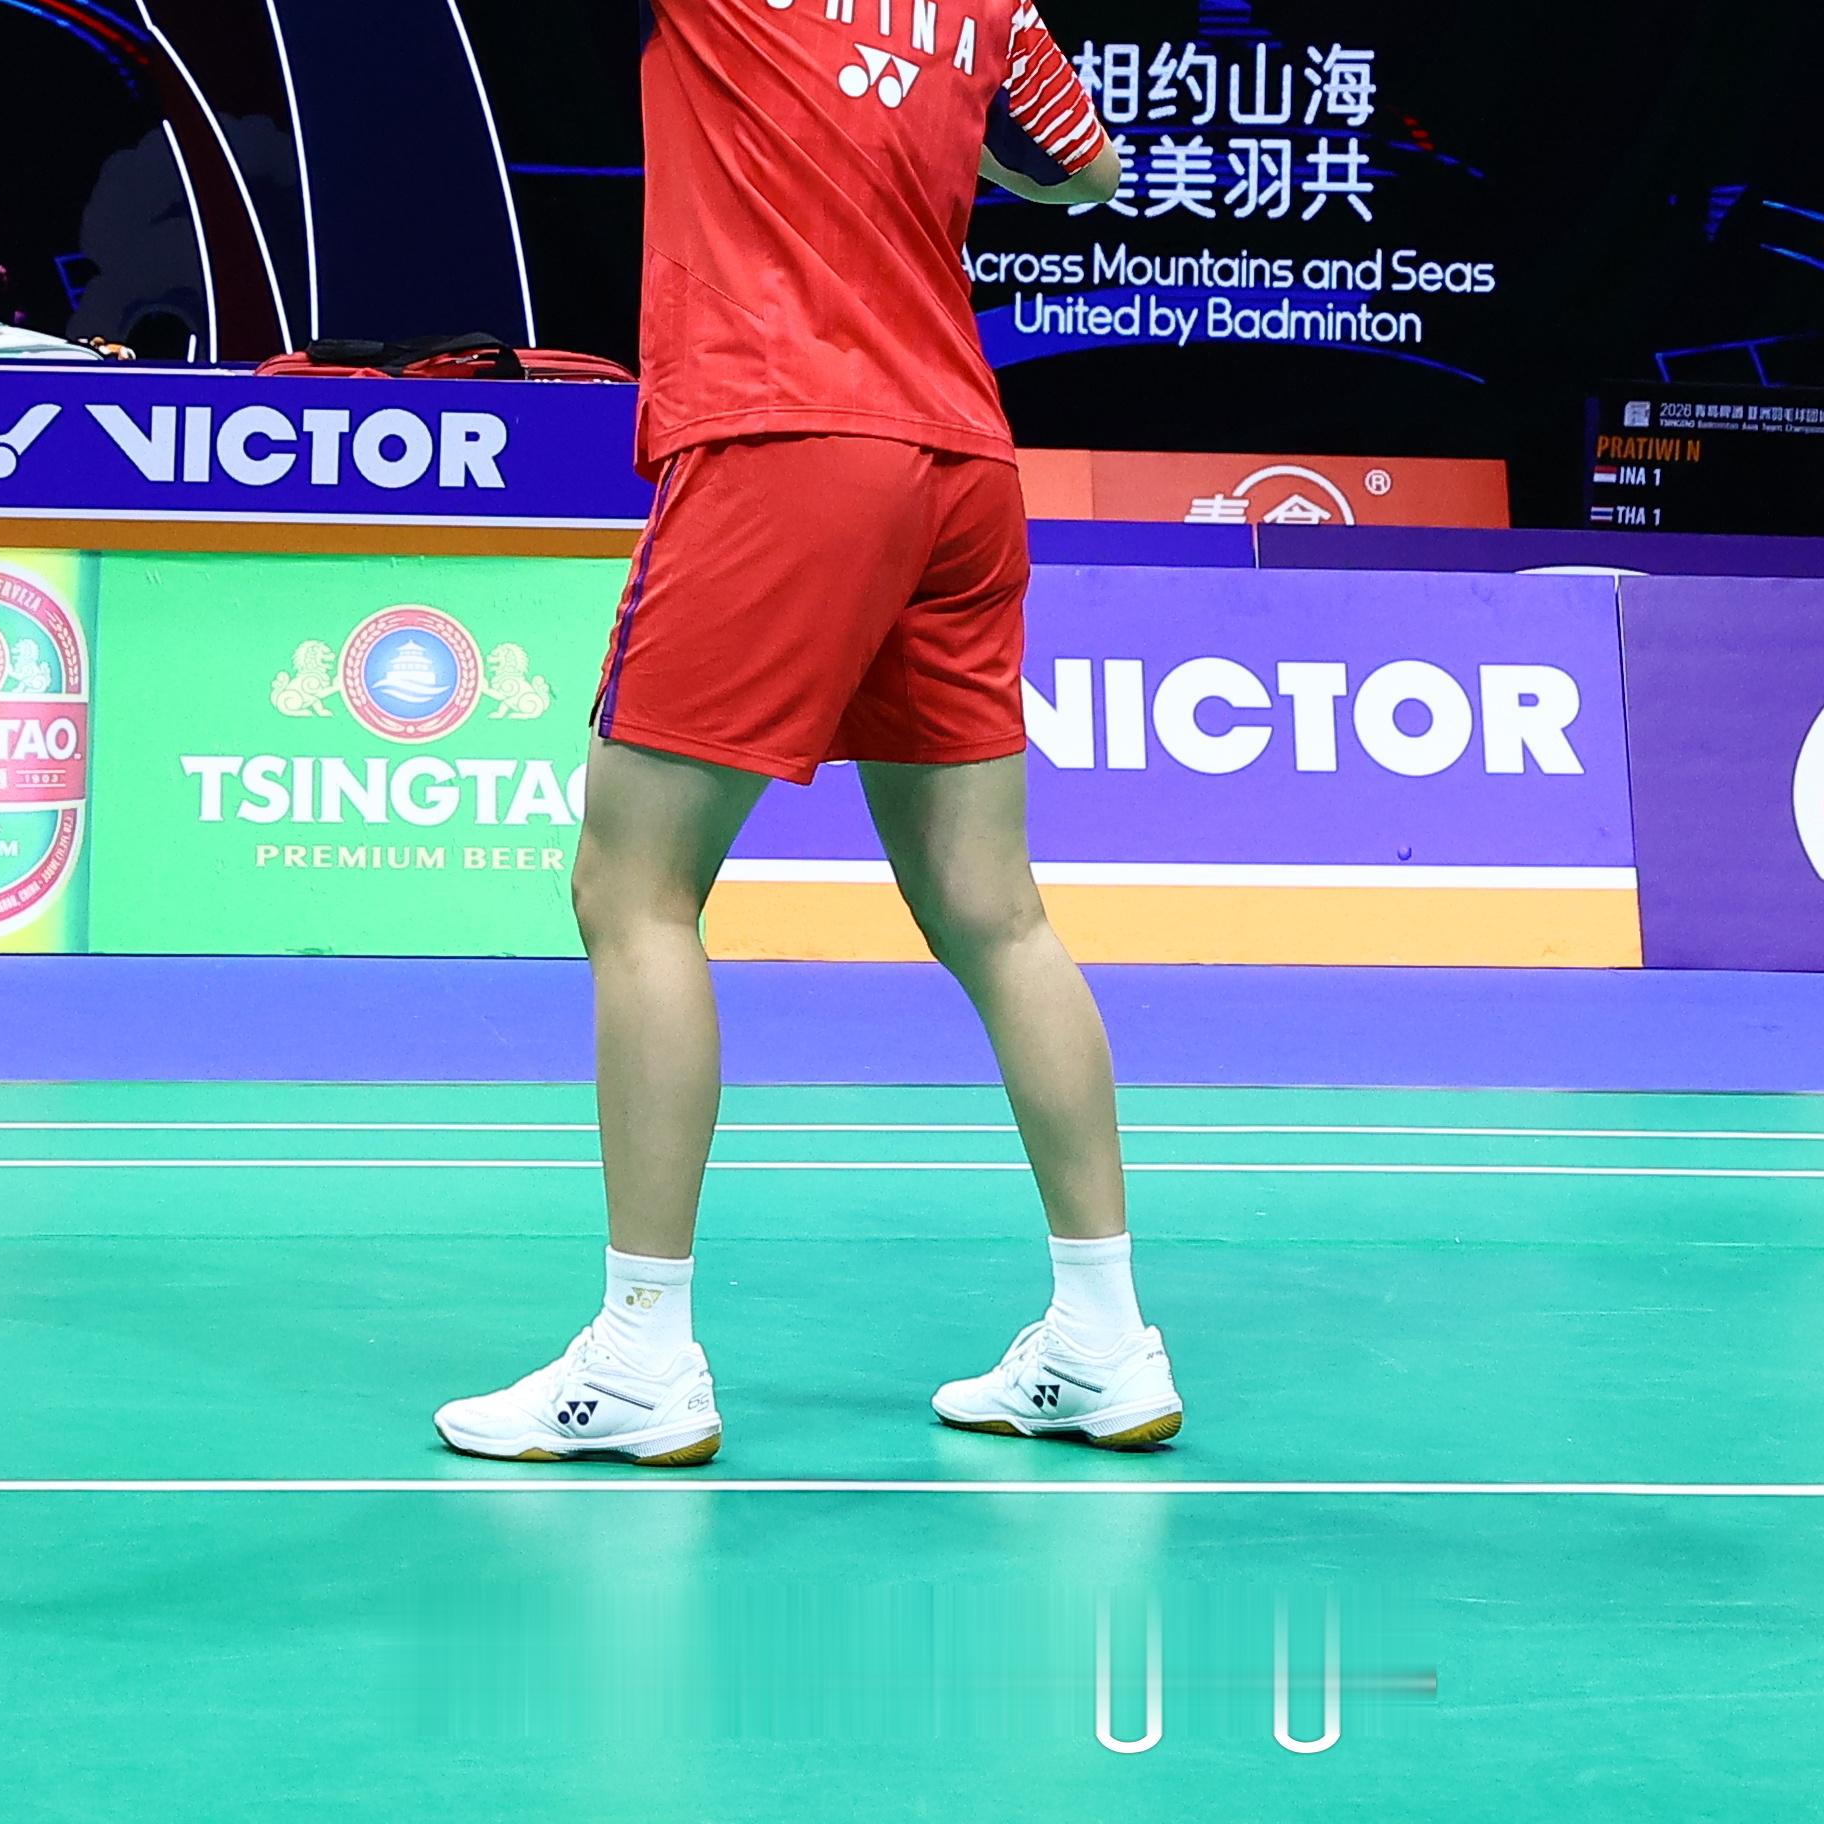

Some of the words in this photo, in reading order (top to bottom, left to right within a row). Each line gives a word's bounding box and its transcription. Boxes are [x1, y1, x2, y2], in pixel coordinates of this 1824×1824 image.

[1072, 39, 1377, 126] 相约山海
[1092, 243, 1295, 290] Mountains
[1303, 248, 1383, 292] and
[1391, 250, 1497, 294] Seas
[1014, 292, 1142, 337] United
[1148, 293, 1199, 347] by
[1207, 295, 1423, 343] Badminton
[87, 404, 509, 490] VICTOR
[1596, 435, 1679, 462] PRATIWI
[1687, 440, 1701, 463] N
[1619, 466, 1647, 487] INA
[1653, 468, 1661, 487] 1
[1616, 505, 1647, 526] THA
[1653, 508, 1661, 526] 1
[1021, 656, 1586, 778] VICTOR
[178, 754, 588, 827] TSINGTA
[254, 844, 447, 870] PREMIUM
[462, 846, 566, 872] BEER
